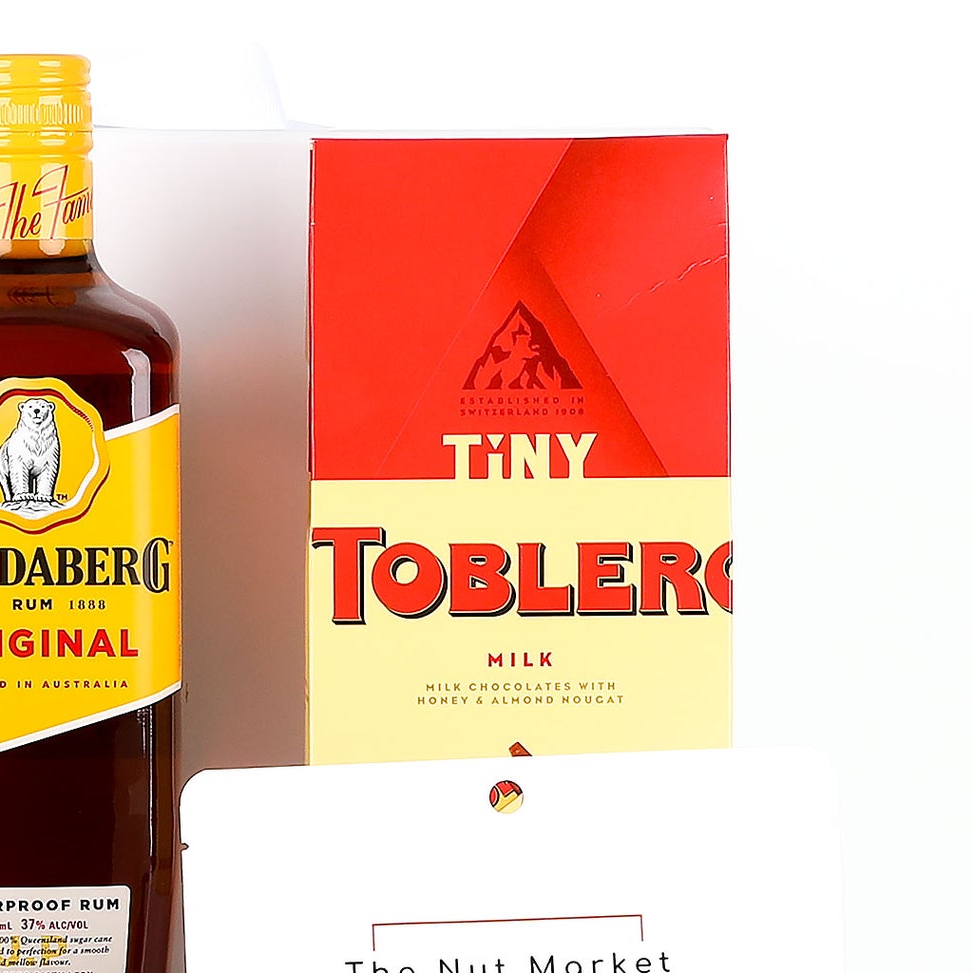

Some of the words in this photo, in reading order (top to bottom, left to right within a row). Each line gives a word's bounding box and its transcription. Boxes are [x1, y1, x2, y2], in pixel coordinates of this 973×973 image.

[32, 165, 93, 239] Fam
[459, 396, 560, 405] ESTABLISHED
[571, 396, 585, 404] IN
[459, 408, 549, 416] SWITZERLAND
[555, 408, 585, 416] 1908
[12, 599, 53, 611] RUM
[68, 599, 107, 611] 1888
[487, 652, 553, 668] MILK
[16, 680, 32, 689] IN
[41, 679, 129, 689] AUSTRALIA
[426, 682, 462, 692] MILK
[468, 682, 572, 692] CHOCOLATES
[579, 681, 616, 692] WITH
[417, 696, 469, 706] HONEY
[476, 696, 484, 705] &
[491, 696, 554, 705] ALMOND
[561, 695, 625, 705] NOUGAT
[80, 899, 119, 911] RUM
[20, 918, 46, 931] 37%
[48, 920, 89, 931] ALC/VOL
[20, 936, 68, 945] Queensland
[17, 946, 57, 957] perfection
[58, 947, 71, 956] for
[80, 946, 109, 954] smooth
[8, 958, 38, 966] mellow
[39, 957, 71, 967] flavour.
